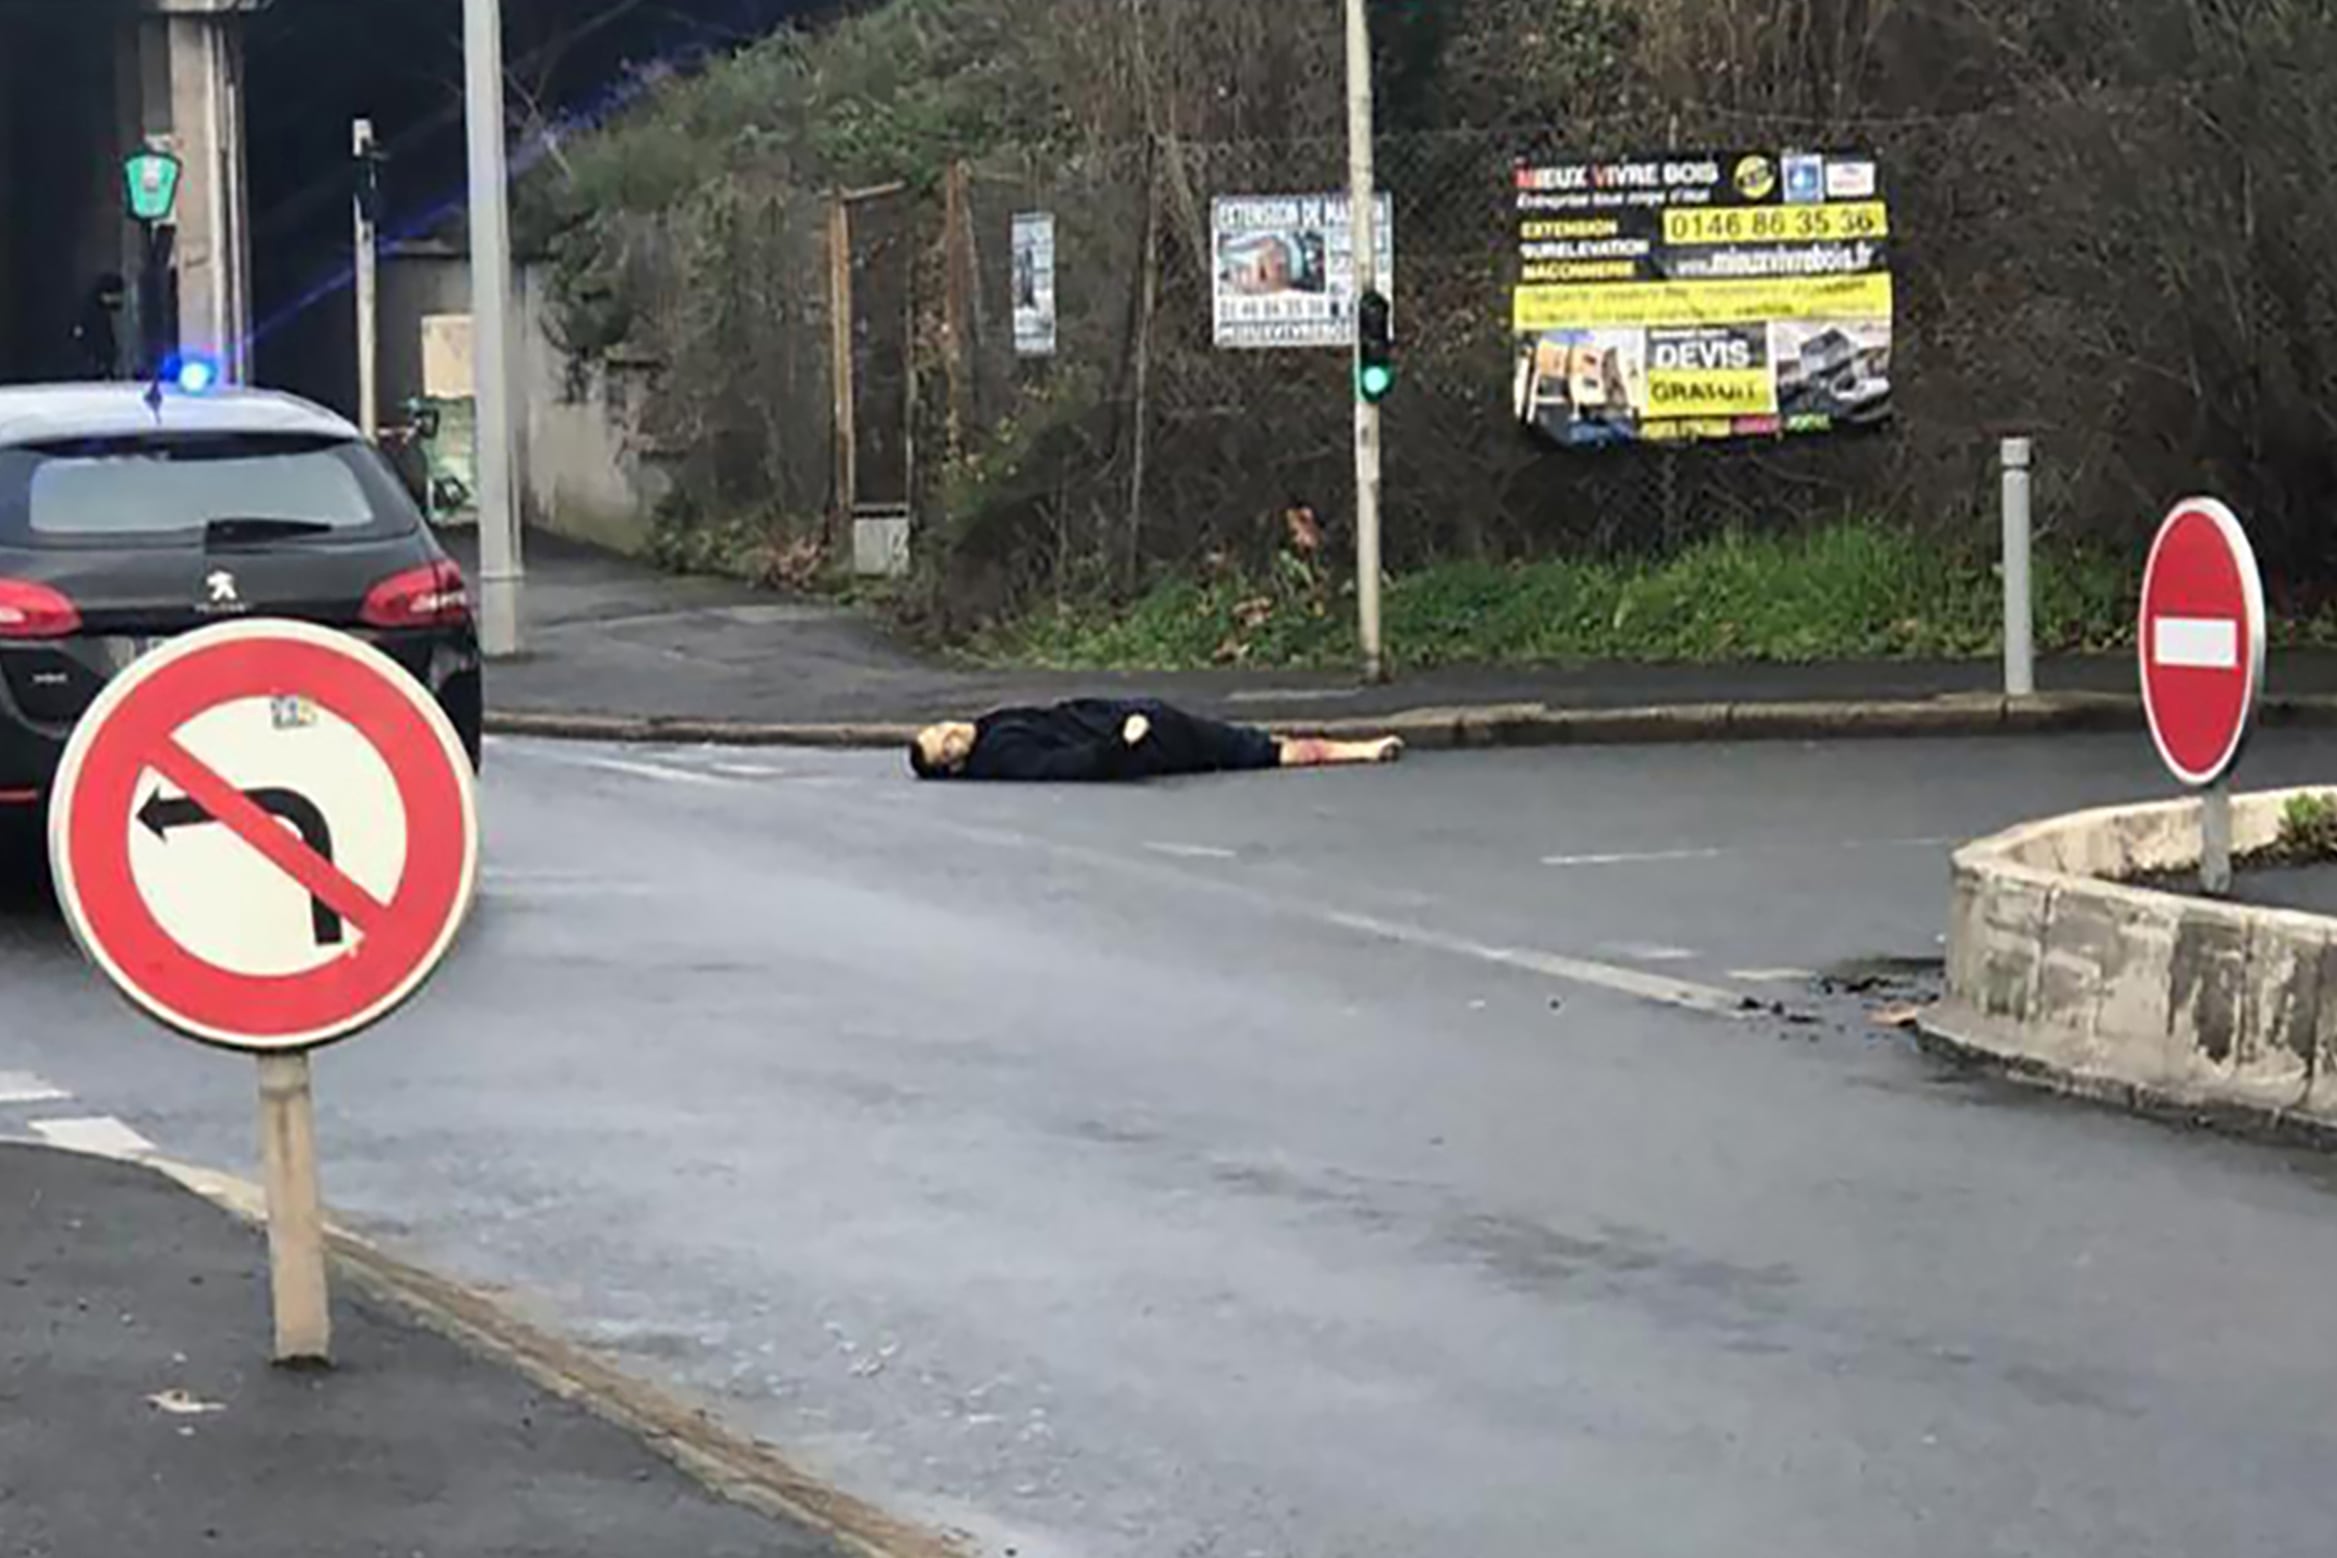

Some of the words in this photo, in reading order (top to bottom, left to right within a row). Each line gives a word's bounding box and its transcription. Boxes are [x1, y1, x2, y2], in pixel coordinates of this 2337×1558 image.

[1516, 165, 1587, 189] MIEUX
[1592, 163, 1659, 187] VIVRE
[1664, 161, 1719, 184] BOIS
[1520, 220, 1618, 239] EXTENSION
[1752, 210, 1785, 236] 86
[1796, 209, 1830, 235] 35
[1840, 208, 1874, 233] 36
[1655, 339, 1750, 369] DEVIS
[1651, 380, 1756, 401] GRATUIT
